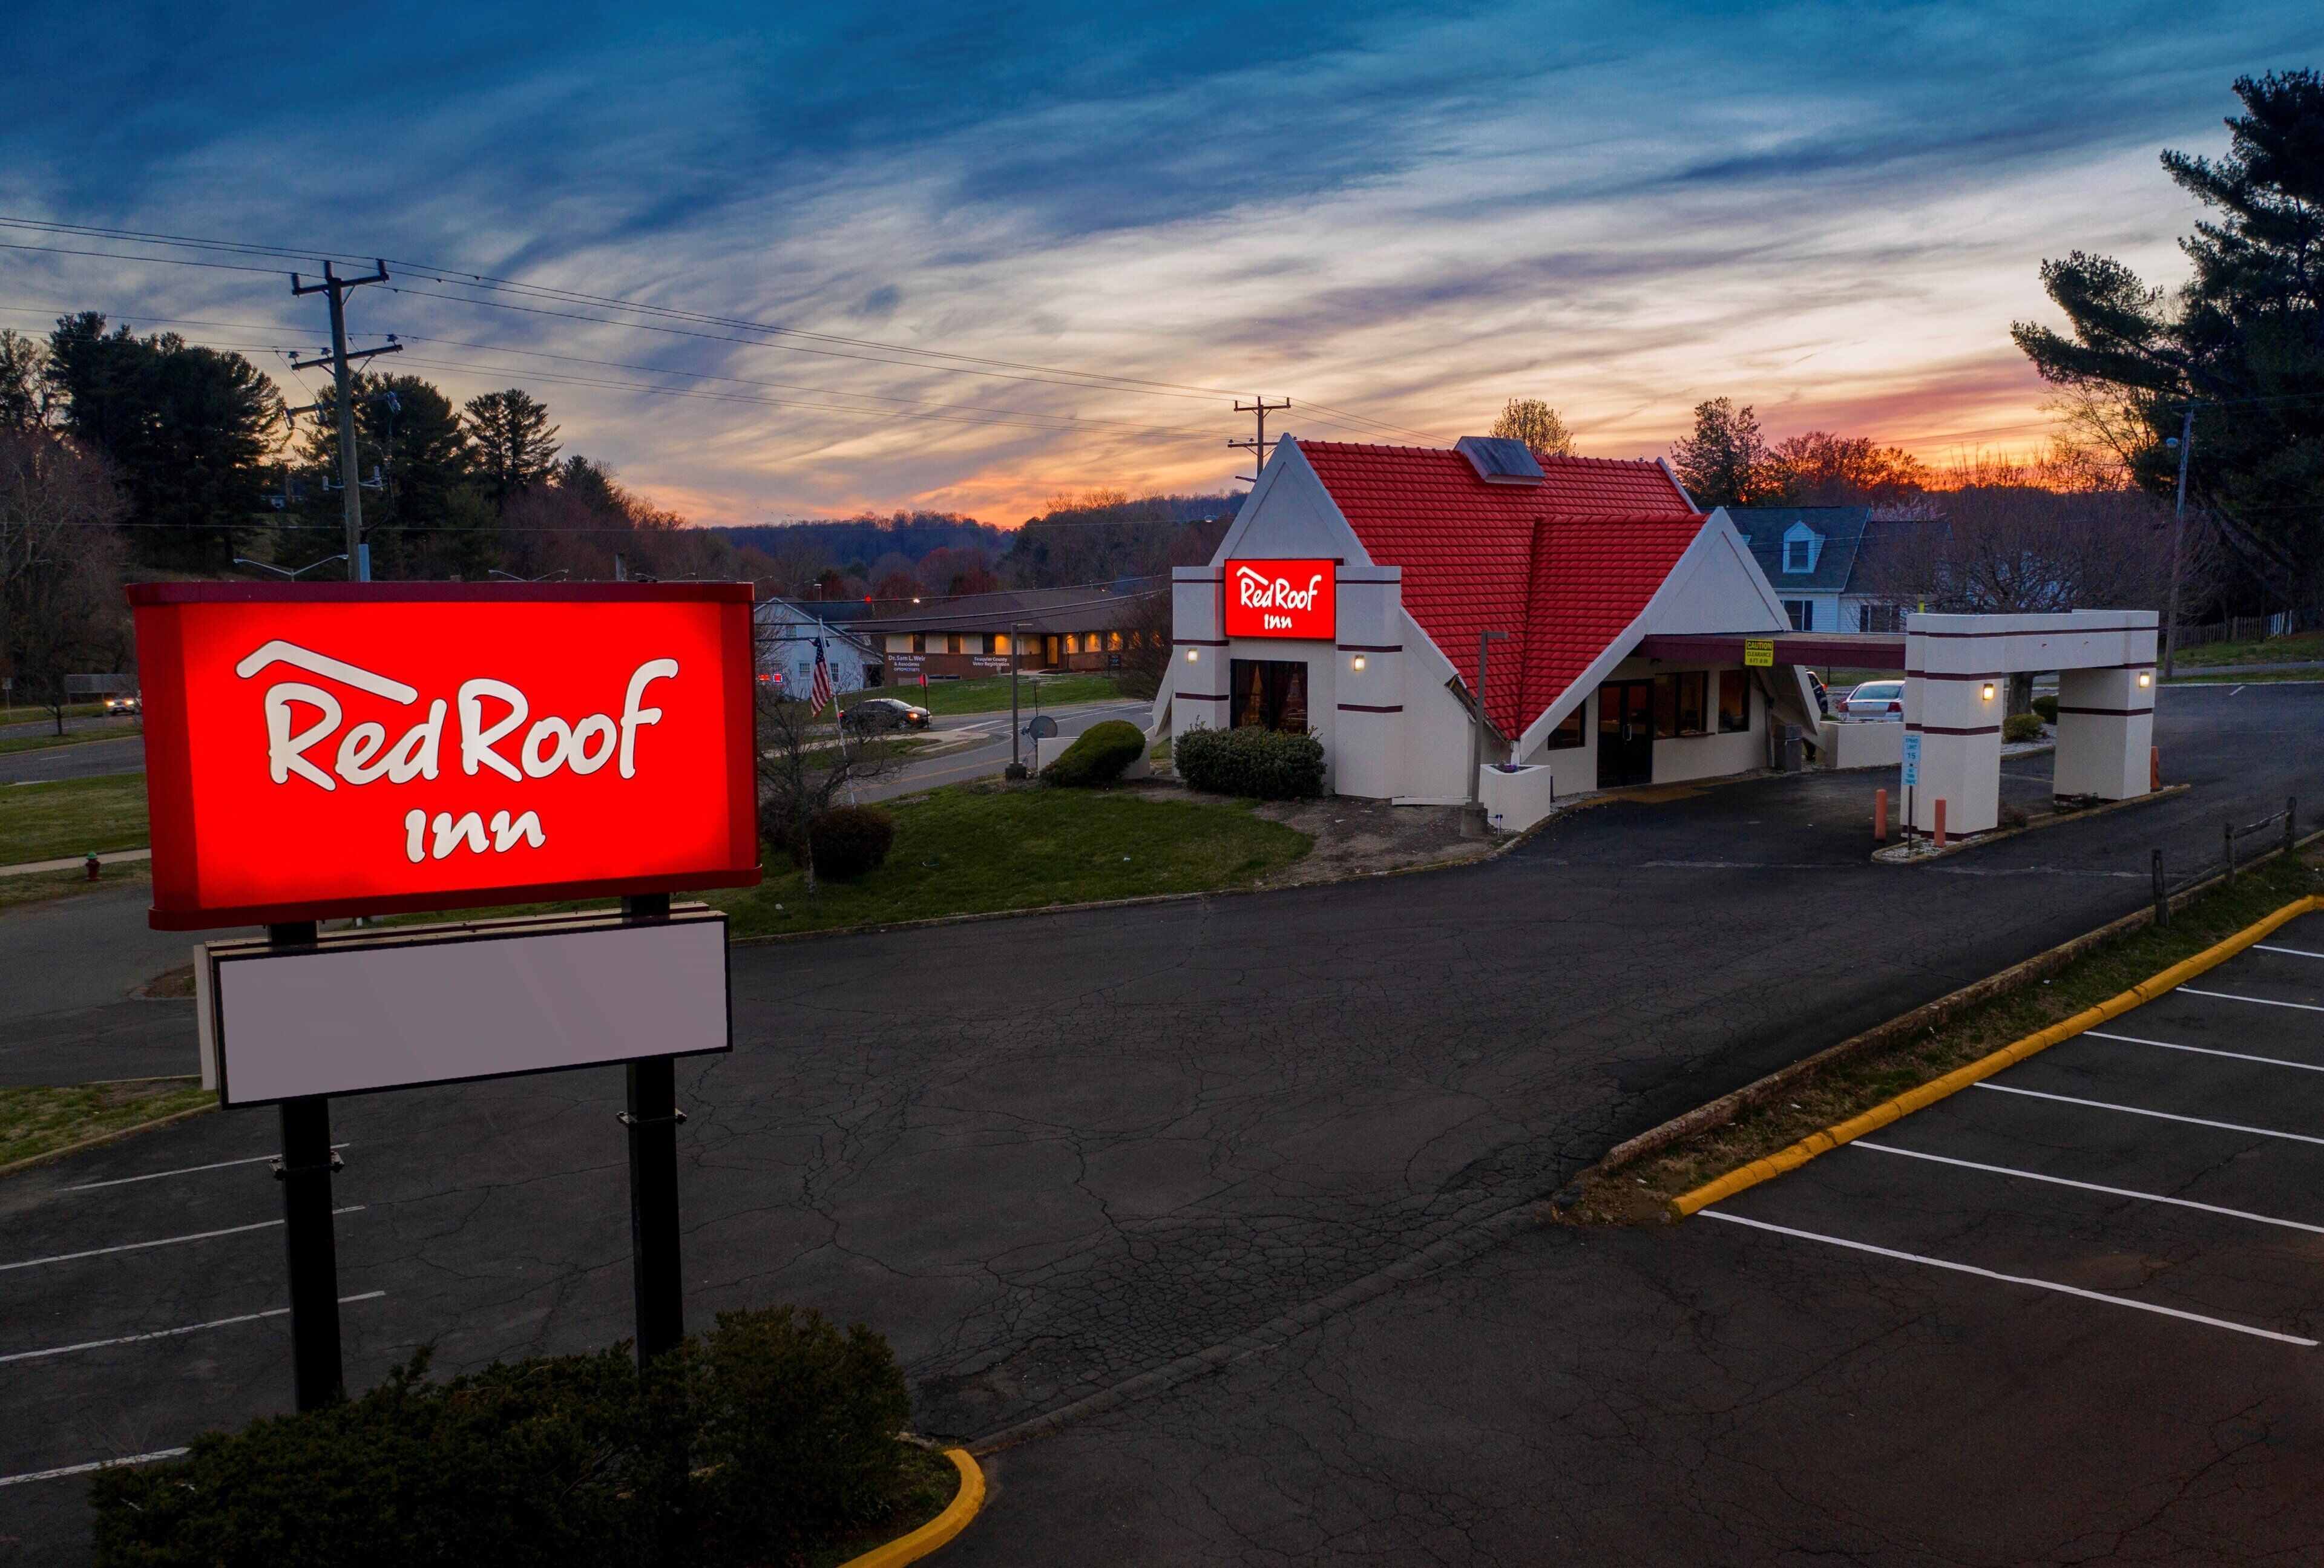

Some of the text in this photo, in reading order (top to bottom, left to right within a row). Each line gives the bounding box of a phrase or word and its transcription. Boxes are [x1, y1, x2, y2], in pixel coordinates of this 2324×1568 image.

[1241, 574, 1322, 611] Red Roof
[1264, 614, 1293, 630] Inn
[264, 658, 680, 792] Red Roof
[404, 809, 547, 864] Inn
